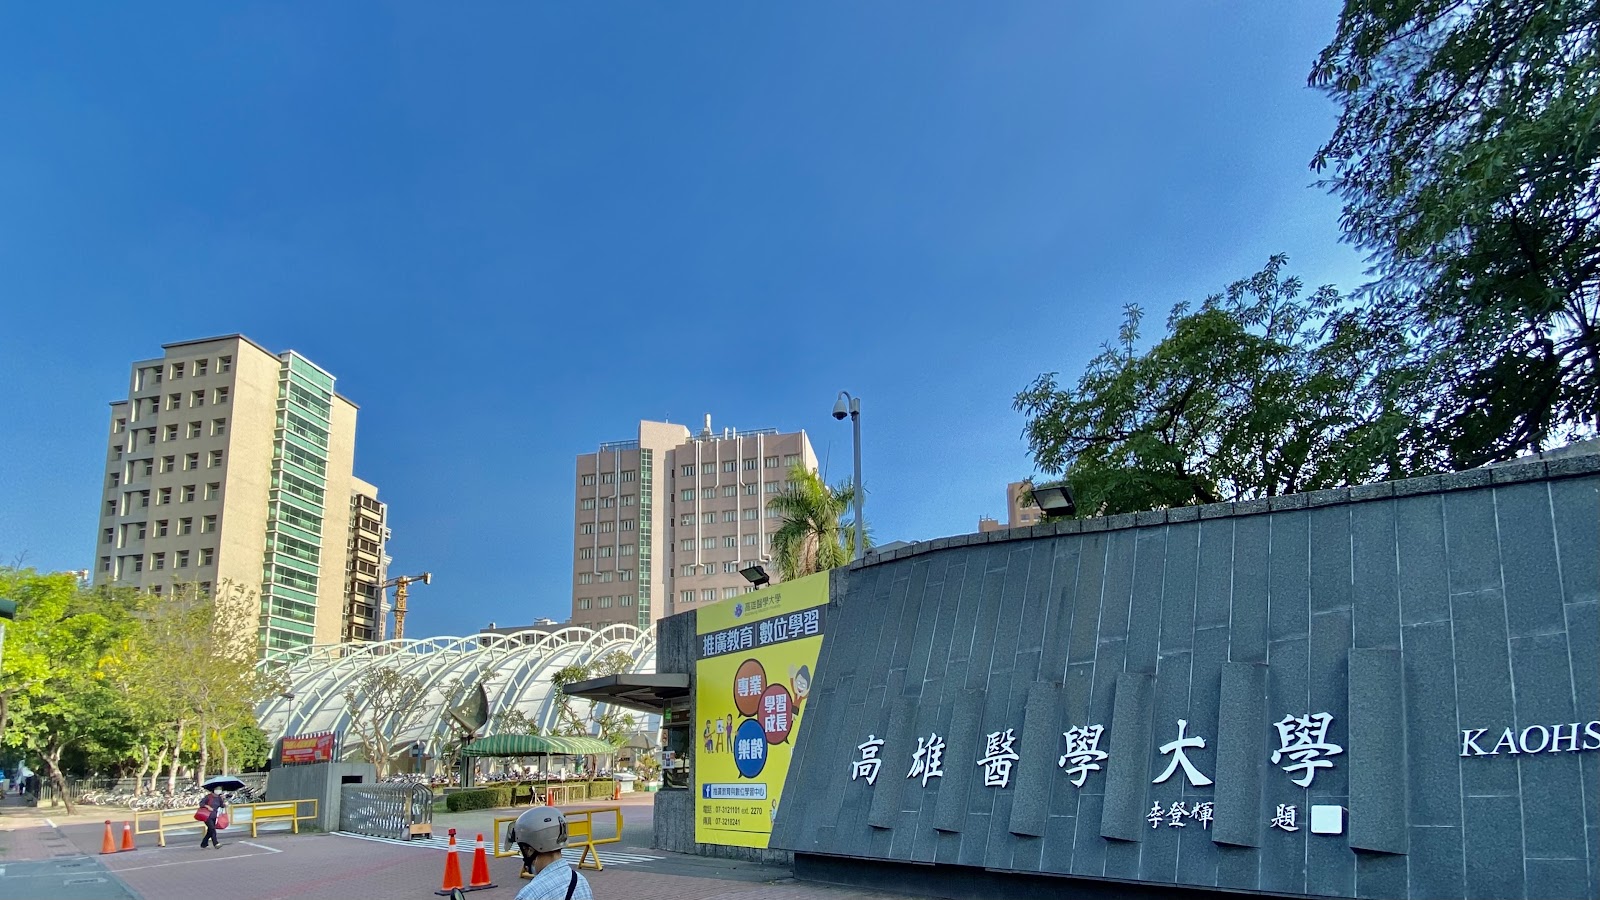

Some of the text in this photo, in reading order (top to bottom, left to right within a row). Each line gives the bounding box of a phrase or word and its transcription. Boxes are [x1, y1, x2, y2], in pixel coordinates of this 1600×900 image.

[745, 593, 782, 612] 高雄醫學大學
[703, 609, 819, 656] 推廣教育 數位學習
[738, 675, 761, 696] 專業
[765, 693, 787, 713] 學習
[765, 713, 787, 732] 成長
[738, 738, 763, 760] 樂齡
[852, 711, 1343, 788] 高雄醫學大學
[751, 807, 763, 815] 2270
[1146, 801, 1299, 831] 李登輝 題
